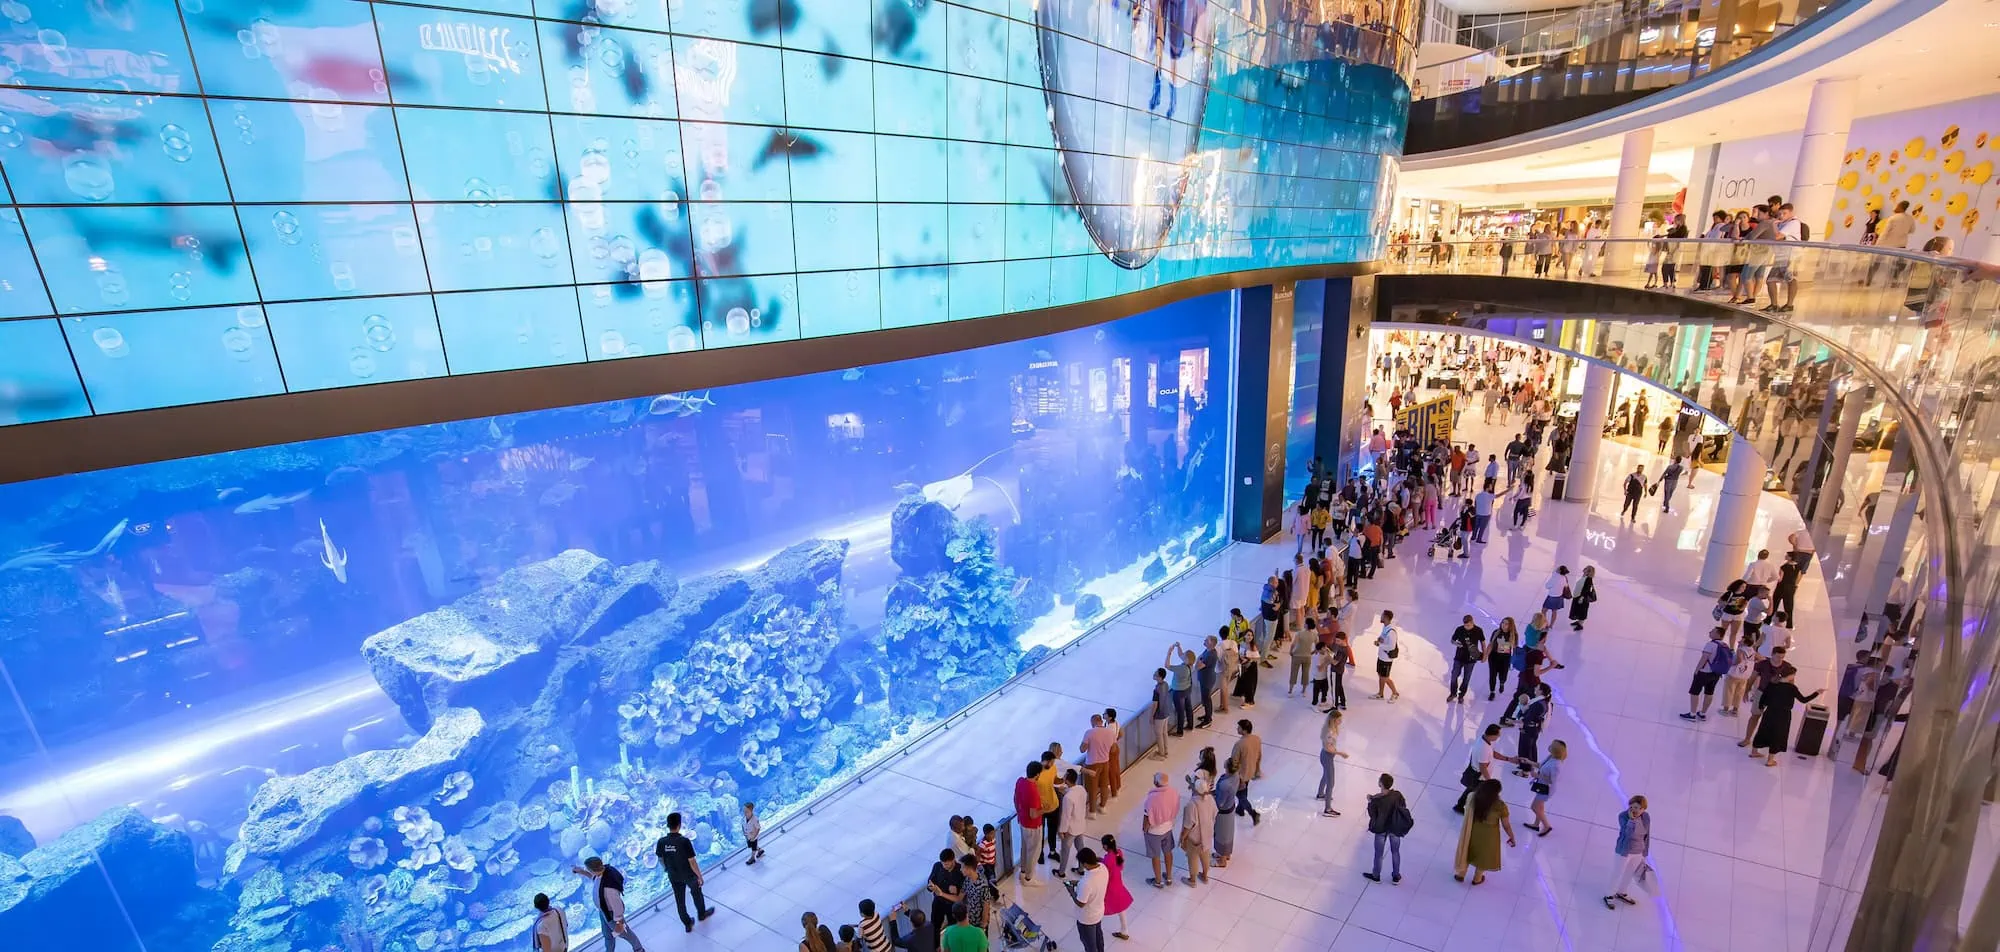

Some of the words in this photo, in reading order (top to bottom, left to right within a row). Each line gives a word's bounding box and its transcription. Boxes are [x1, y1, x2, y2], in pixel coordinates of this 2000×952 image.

[1718, 175, 1725, 199] i
[1725, 177, 1756, 199] am
[1680, 406, 1700, 416] ALDO
[1407, 402, 1437, 450] BIG
